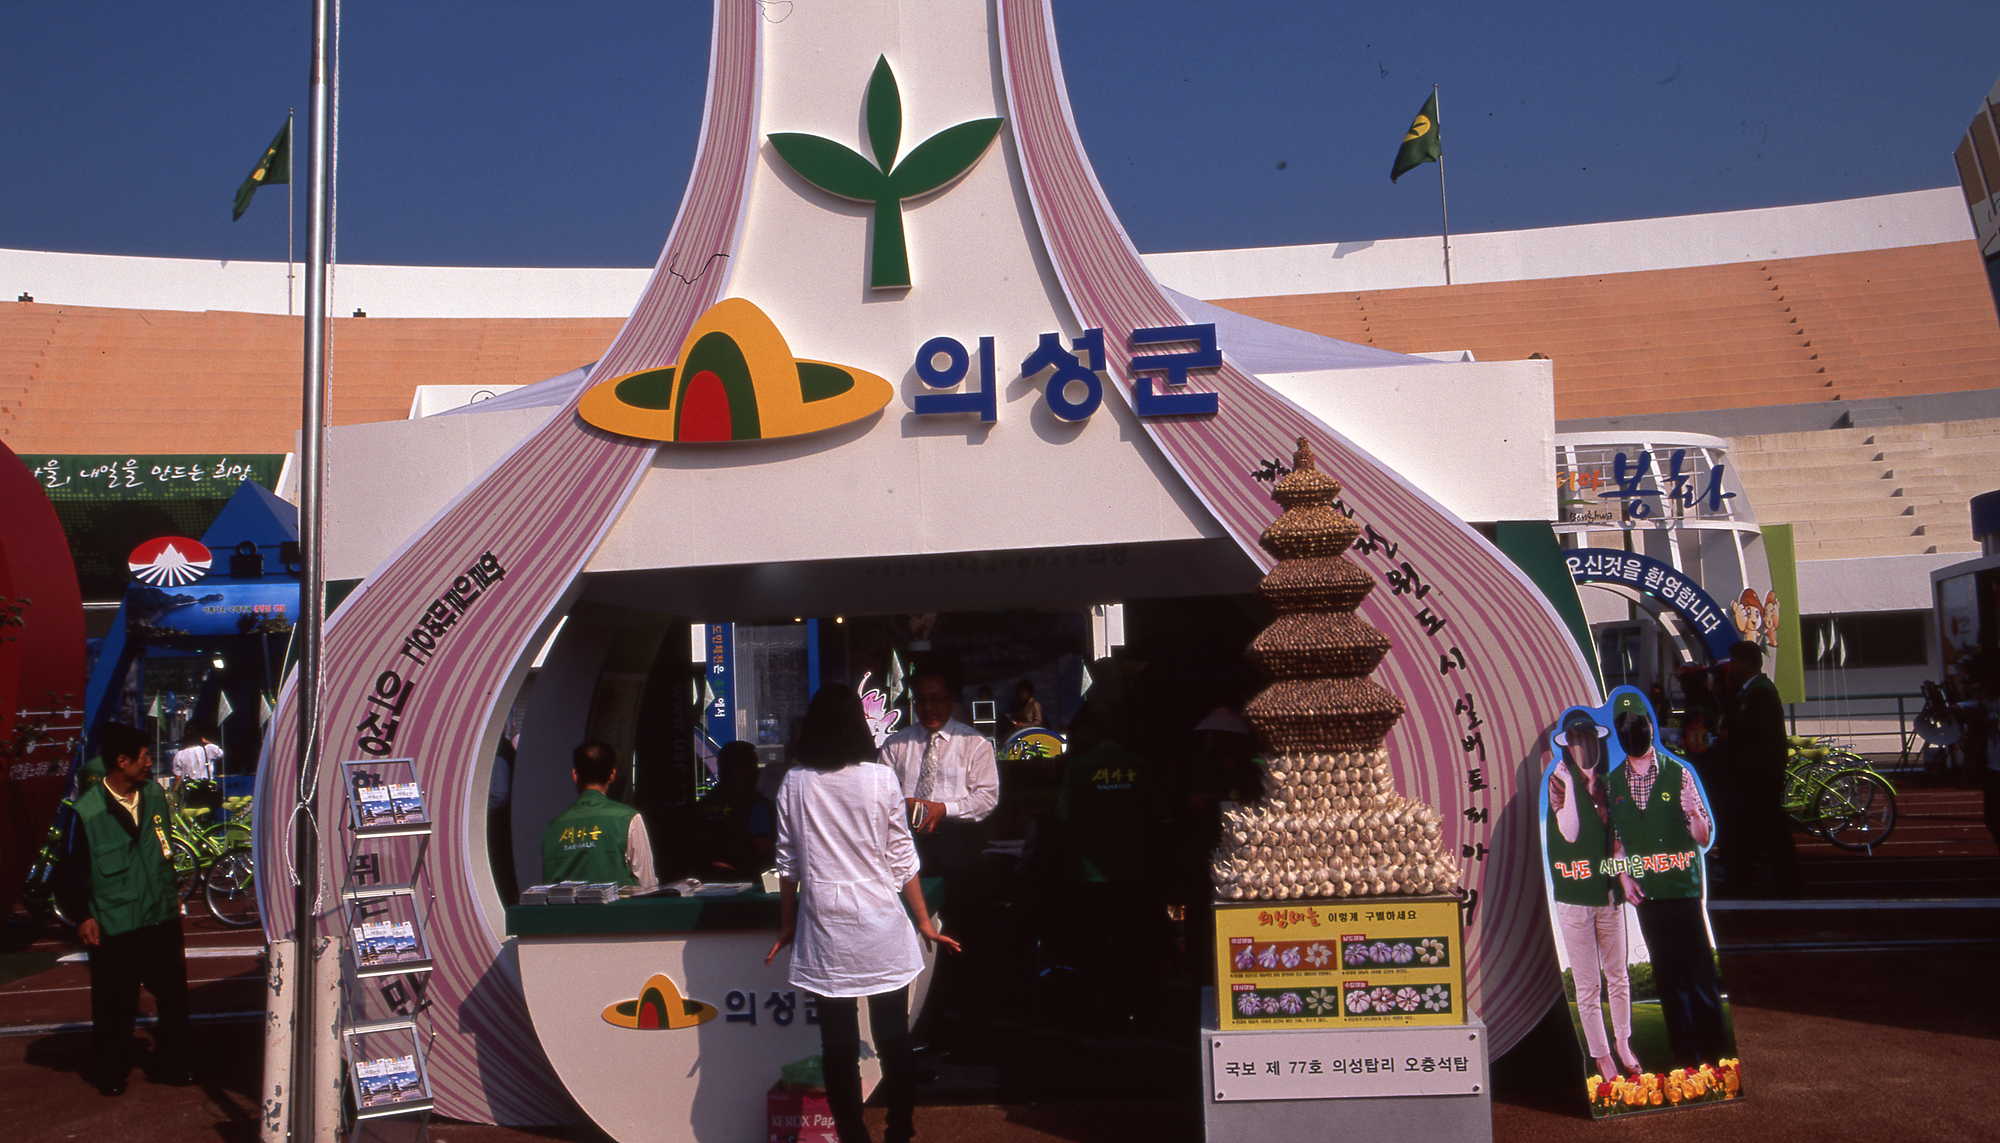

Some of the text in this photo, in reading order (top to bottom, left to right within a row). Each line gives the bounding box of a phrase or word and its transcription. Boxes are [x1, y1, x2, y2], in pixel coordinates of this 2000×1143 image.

[914, 323, 1223, 422] 의성군
[80, 460, 144, 488] 내일을
[1597, 449, 1736, 519] 봉화
[1570, 510, 1612, 524] Bonghwa
[1566, 555, 1722, 635] 오신것을 환영합니다
[356, 670, 415, 757] 의성
[1455, 693, 1488, 861] 실버토피아
[558, 825, 602, 844] 새마을
[1555, 860, 1591, 880] "나도
[1258, 906, 1417, 929] 의성마늘 이렇게 구별하세요
[1225, 1056, 1469, 1076] 국보 제 77호 의성탑리 오층석탑
[771, 1114, 835, 1129] XEROX Pap
